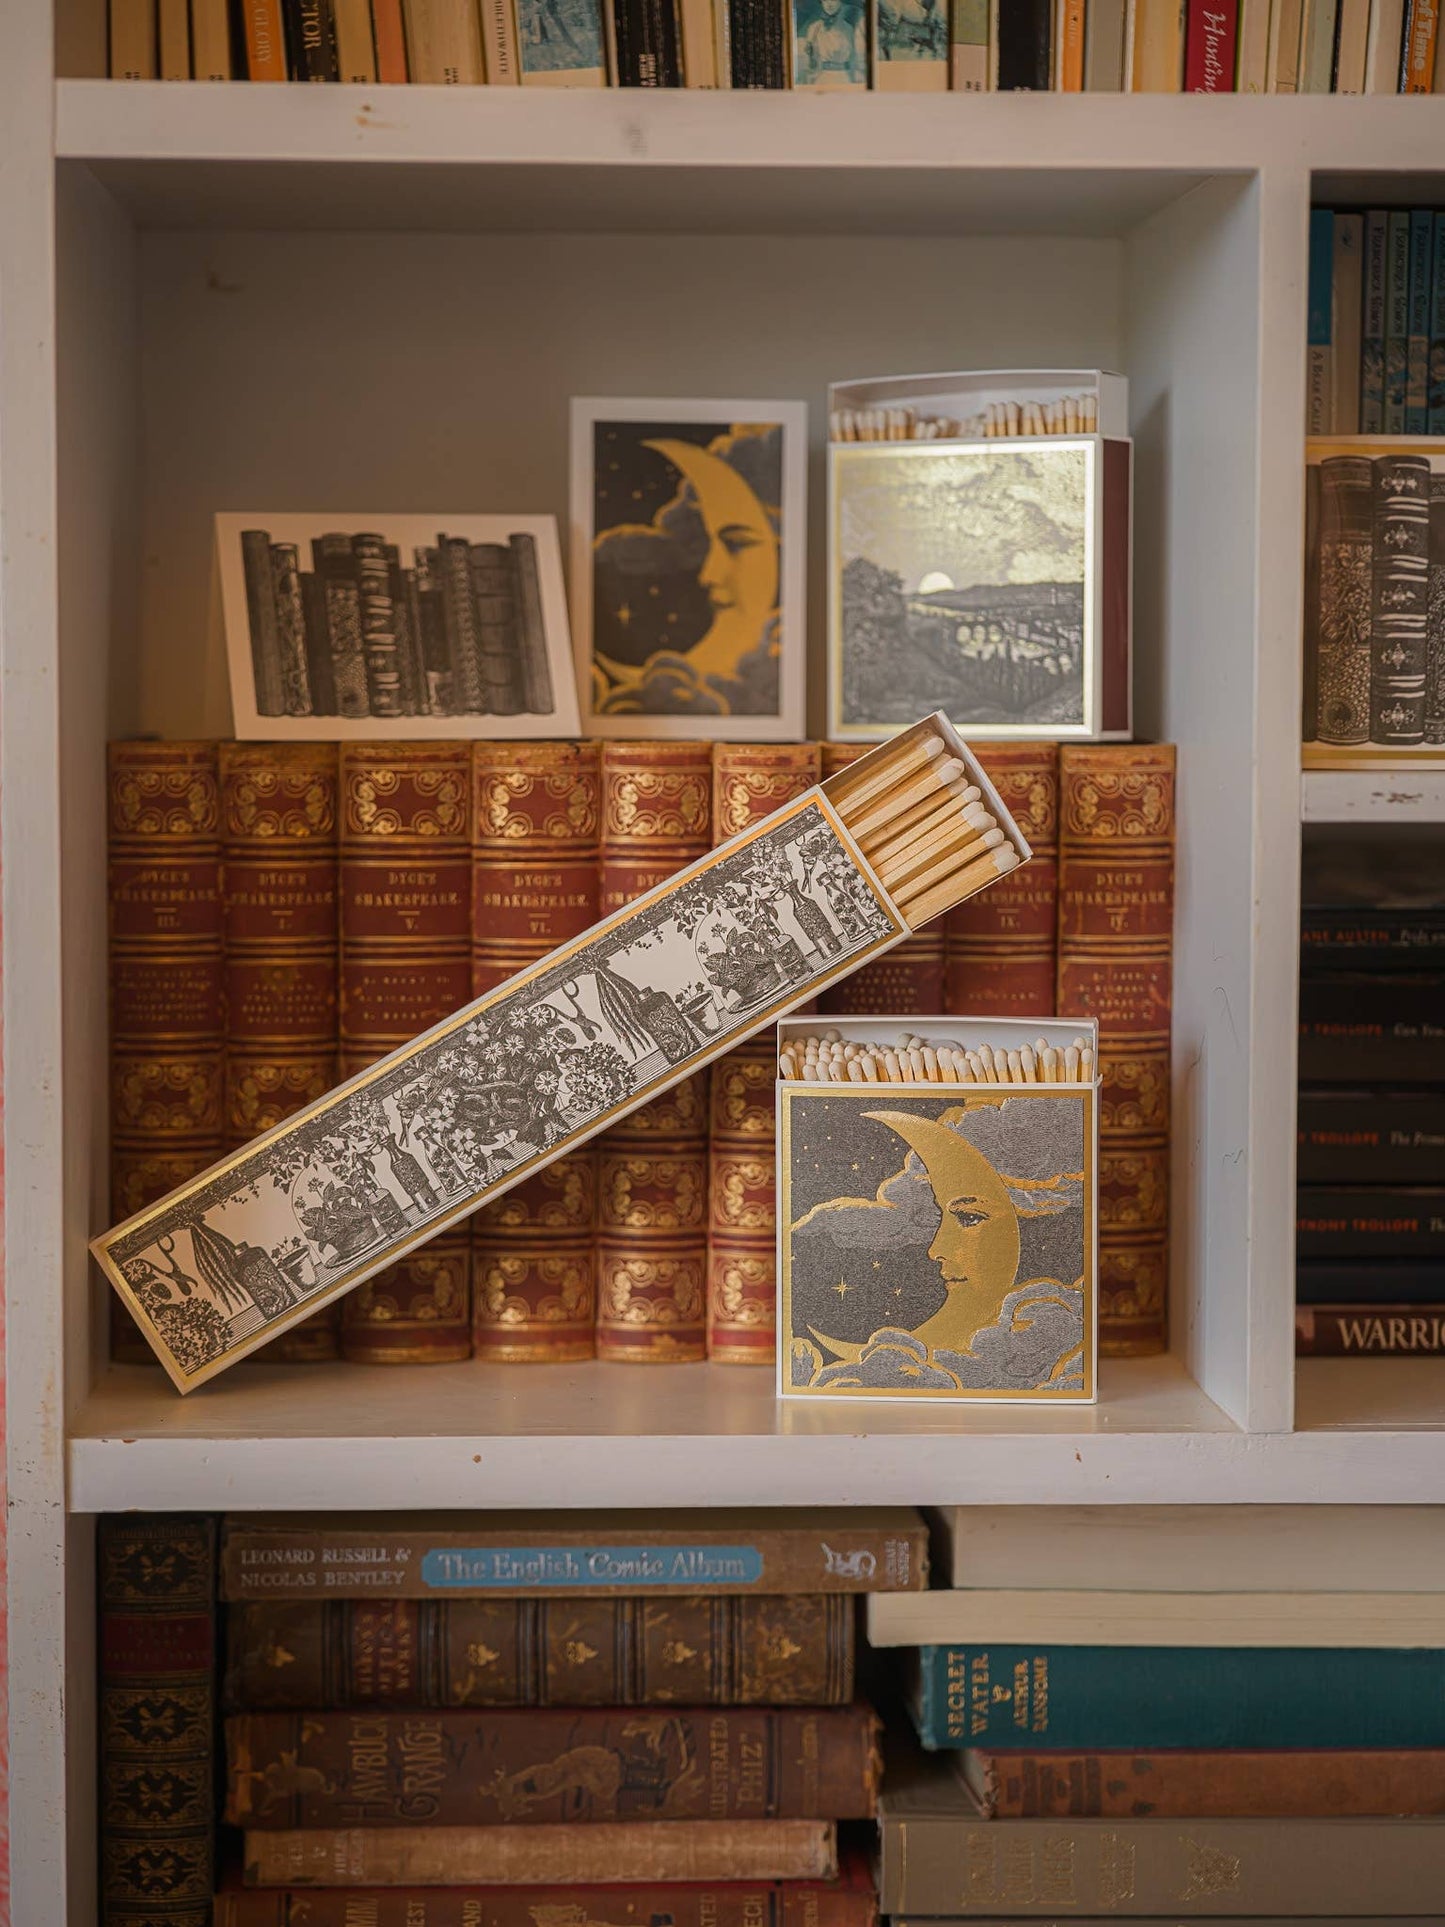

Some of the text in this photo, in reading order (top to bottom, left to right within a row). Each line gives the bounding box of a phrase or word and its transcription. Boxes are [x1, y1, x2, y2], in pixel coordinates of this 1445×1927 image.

[1336, 1318, 1445, 1350] WARRI
[241, 1549, 315, 1565] LEONARD
[322, 1547, 390, 1564] RUSSELL
[241, 1570, 405, 1587] NICOLAS BENTLEY
[438, 1550, 746, 1584] The English Comic Album
[948, 1650, 965, 1738] SECRET
[971, 1652, 989, 1736] WATER
[1014, 1659, 1028, 1728] ARTHUR
[1032, 1655, 1048, 1733] RANSOME
[395, 1719, 446, 1820] GRANGE
